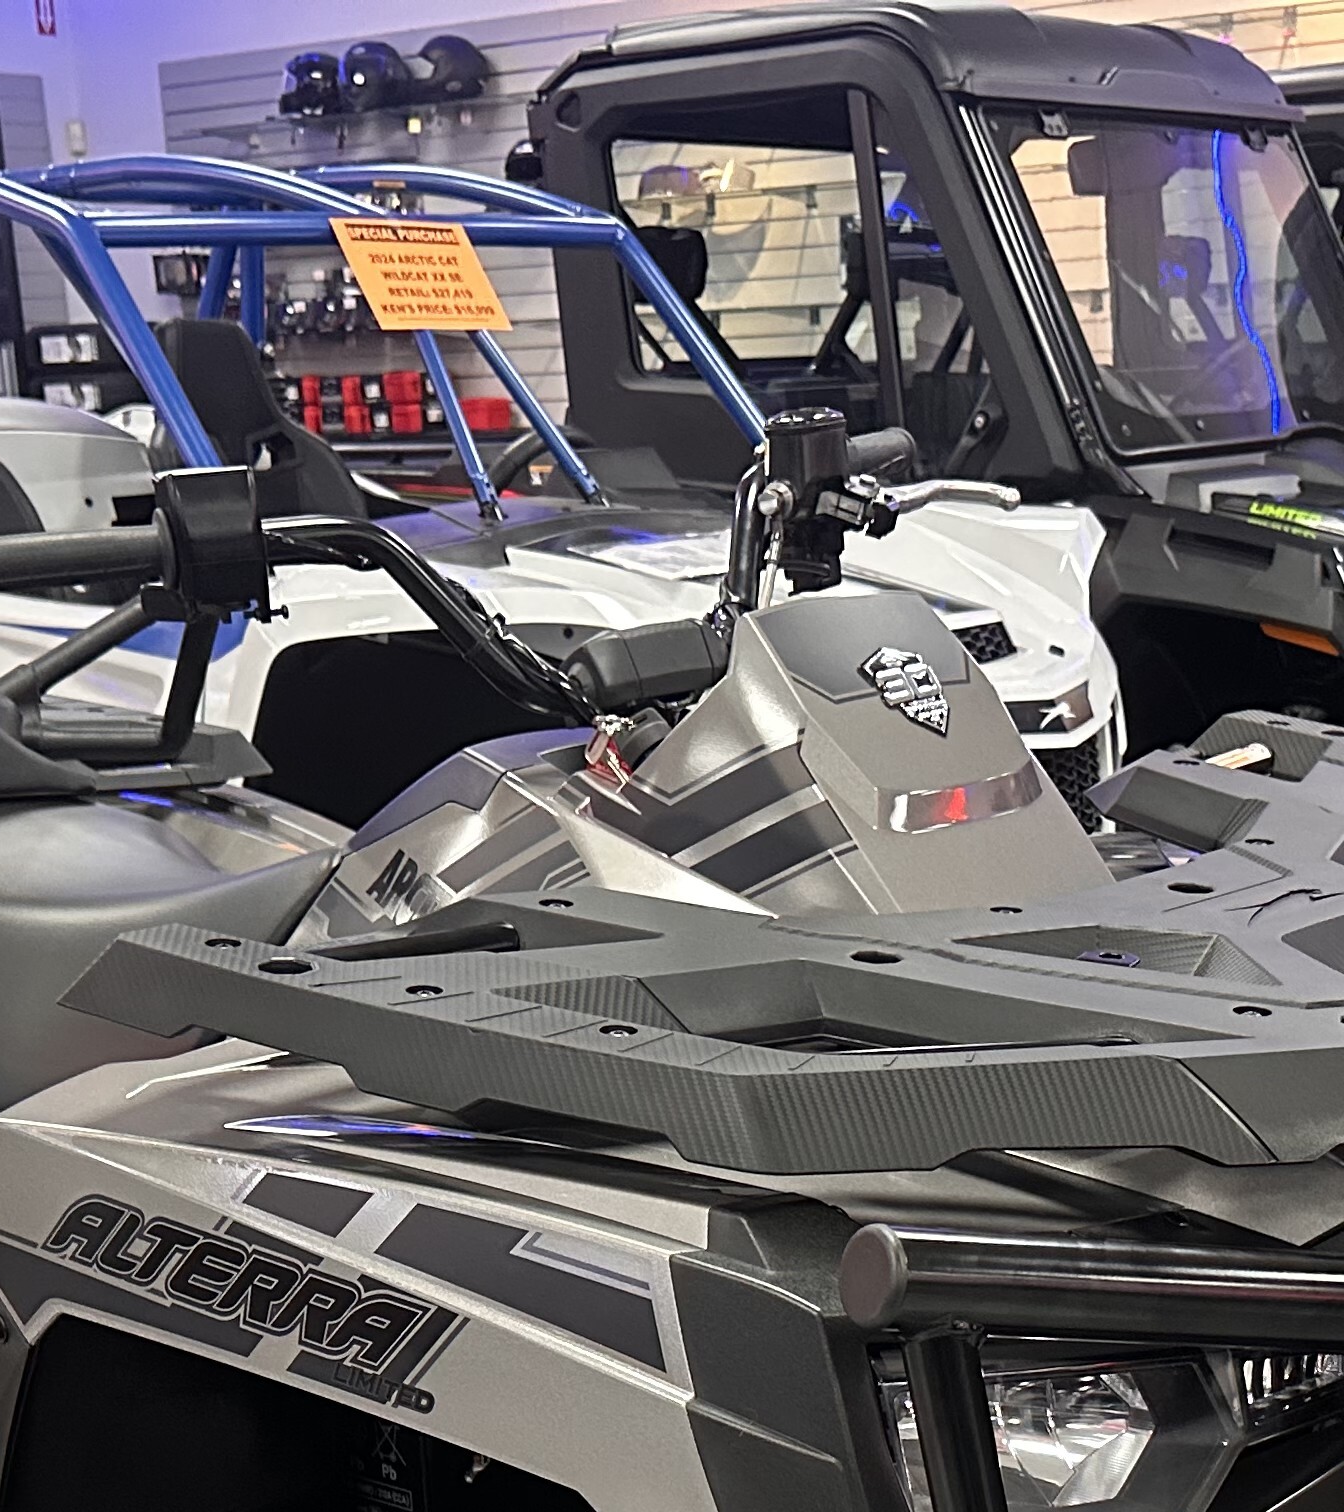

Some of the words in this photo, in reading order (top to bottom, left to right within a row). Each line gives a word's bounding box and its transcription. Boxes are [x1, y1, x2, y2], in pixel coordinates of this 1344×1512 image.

[347, 226, 397, 241] SPECIAL
[397, 228, 459, 243] PURCHASE
[398, 254, 437, 266] ARCTIC
[438, 255, 459, 267] CAT
[380, 271, 429, 282] WILDCAT
[42, 1194, 433, 1375] ALTERRA
[332, 1361, 436, 1415] LIMITED
[381, 1463, 397, 1481] Pb
